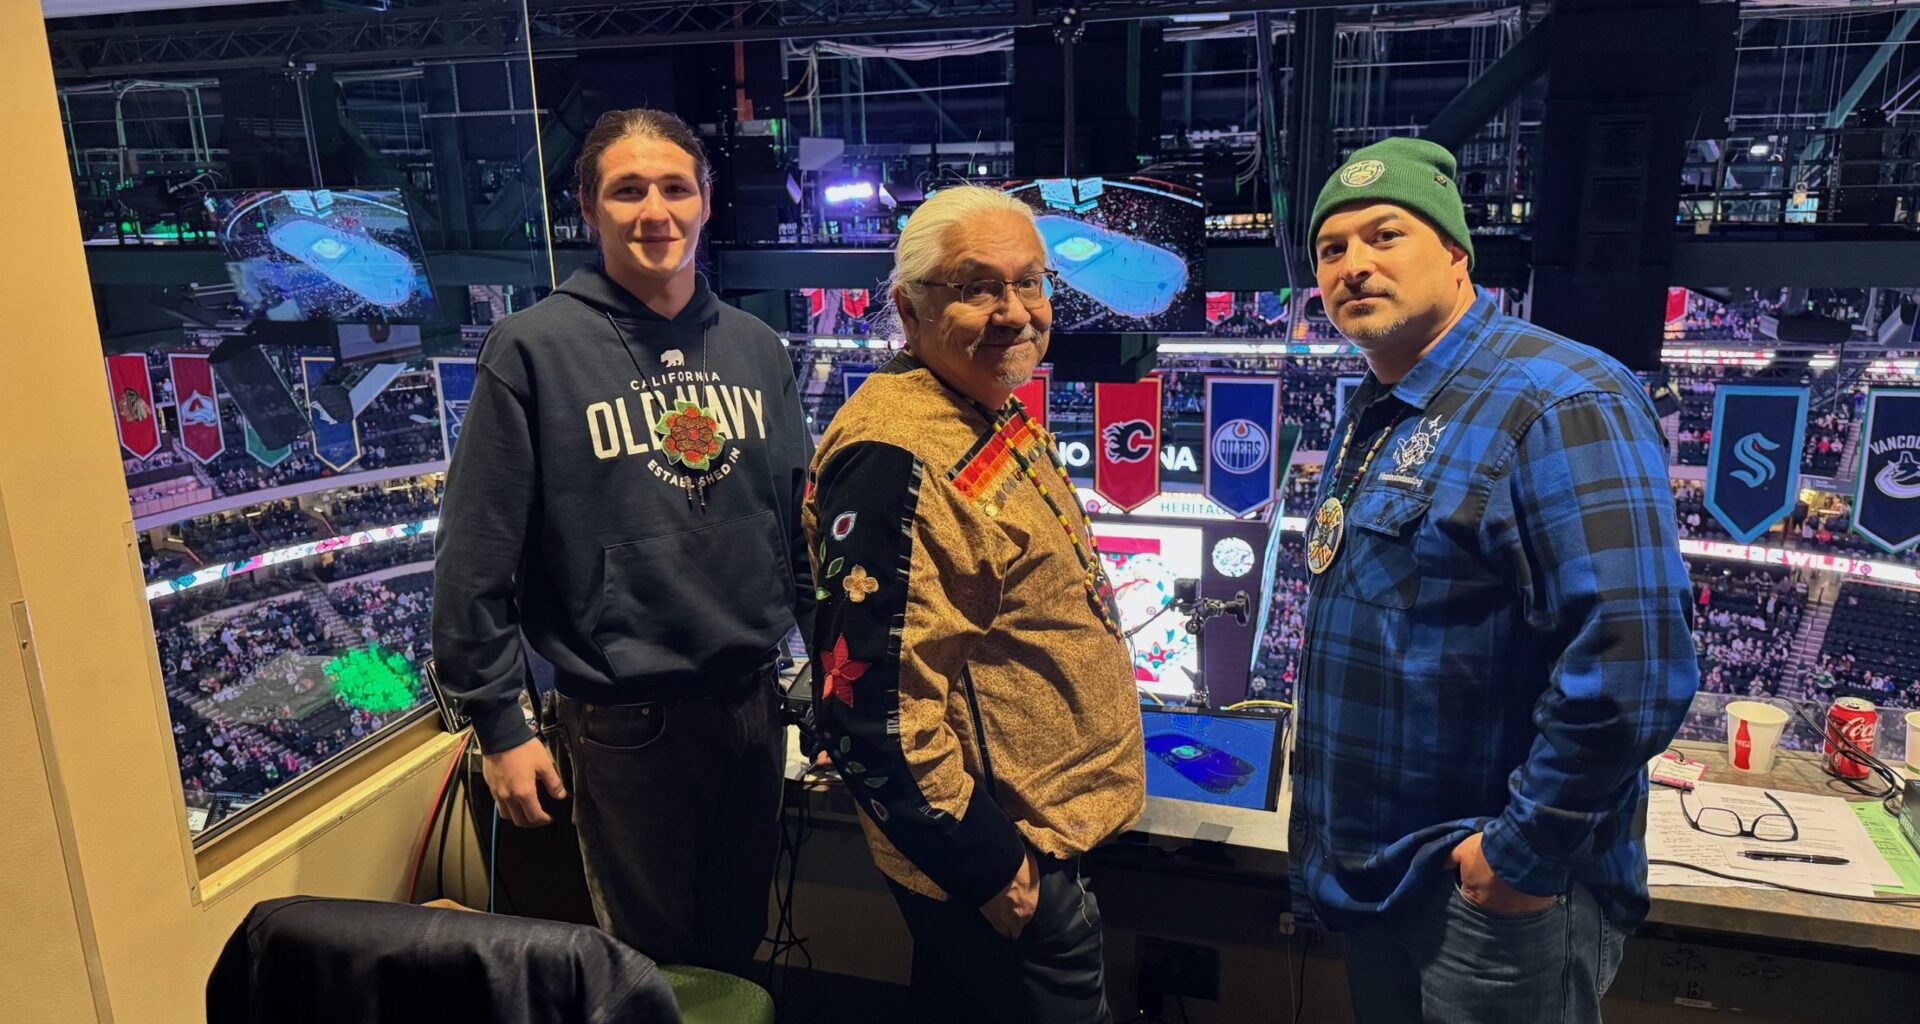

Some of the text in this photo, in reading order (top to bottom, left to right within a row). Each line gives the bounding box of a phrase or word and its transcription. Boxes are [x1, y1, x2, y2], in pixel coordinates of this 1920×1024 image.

[631, 371, 721, 390] CALIFORNIA
[586, 390, 668, 460] OLD
[1220, 439, 1262, 456] OILERS
[647, 447, 741, 489] ESTABLSHED IN
